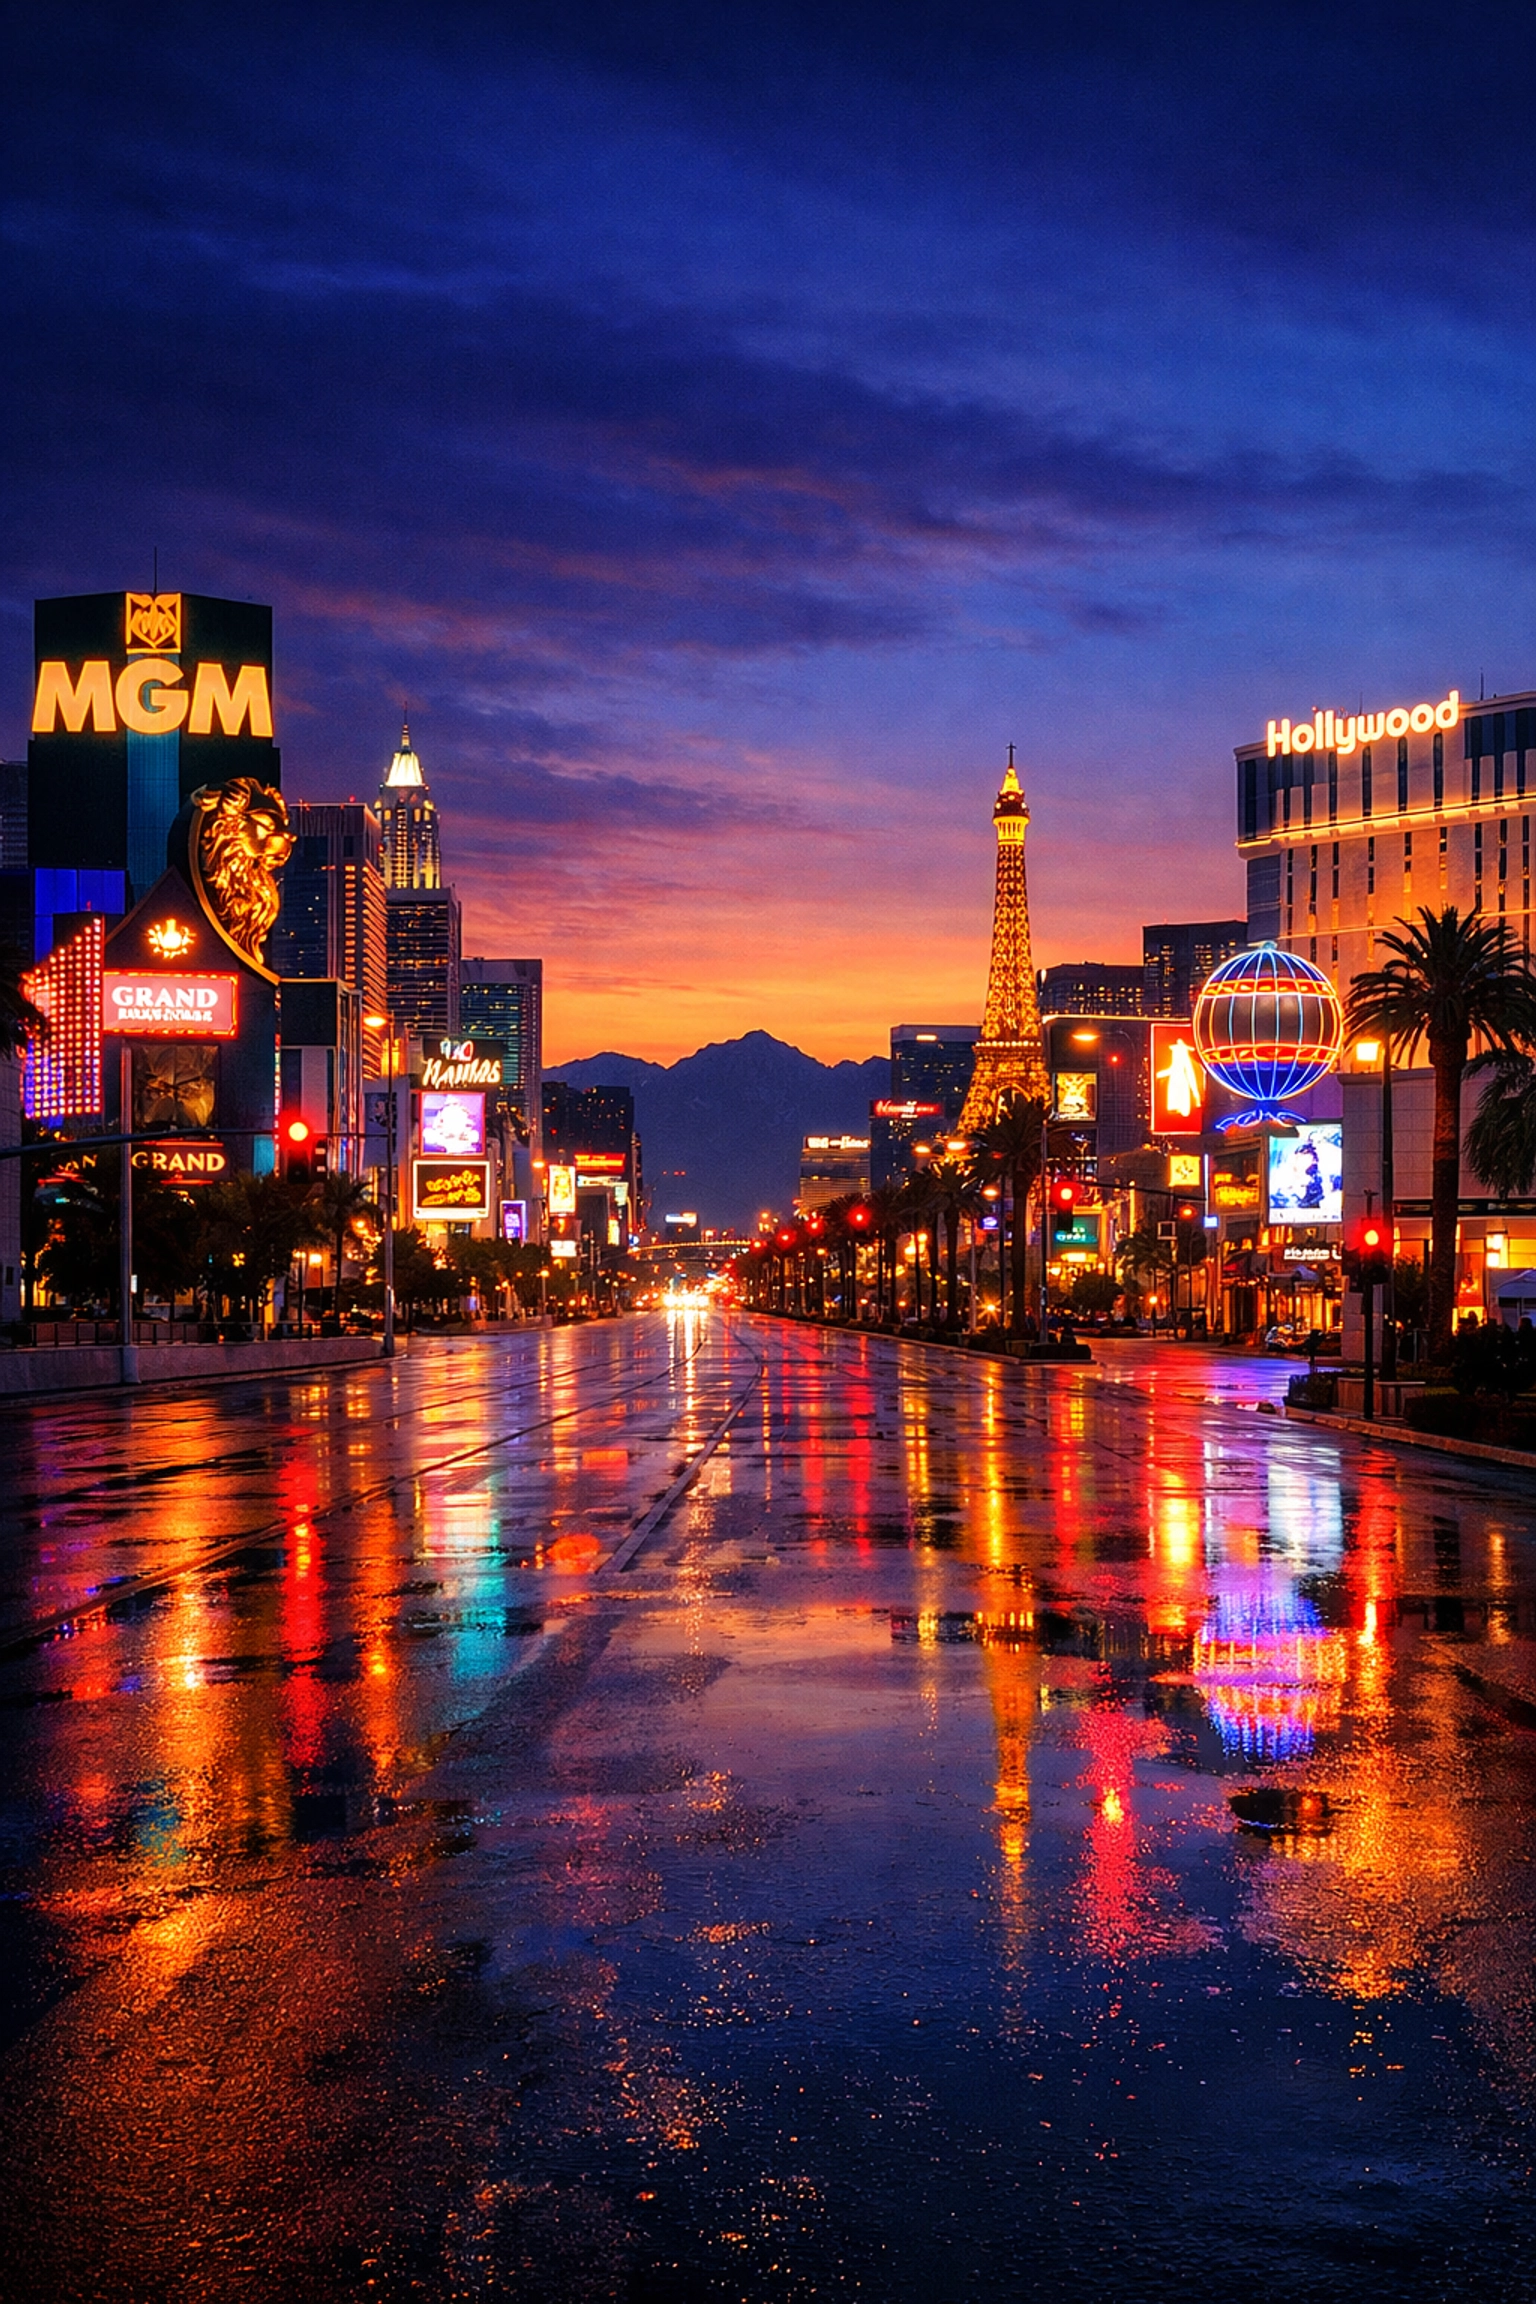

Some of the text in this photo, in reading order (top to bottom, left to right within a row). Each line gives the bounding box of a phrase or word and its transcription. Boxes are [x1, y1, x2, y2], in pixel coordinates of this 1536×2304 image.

[31, 657, 273, 738] MGM
[1266, 689, 1460, 758] Hollywood
[111, 985, 219, 1009] GRAND
[131, 1151, 226, 1172] GRAND
